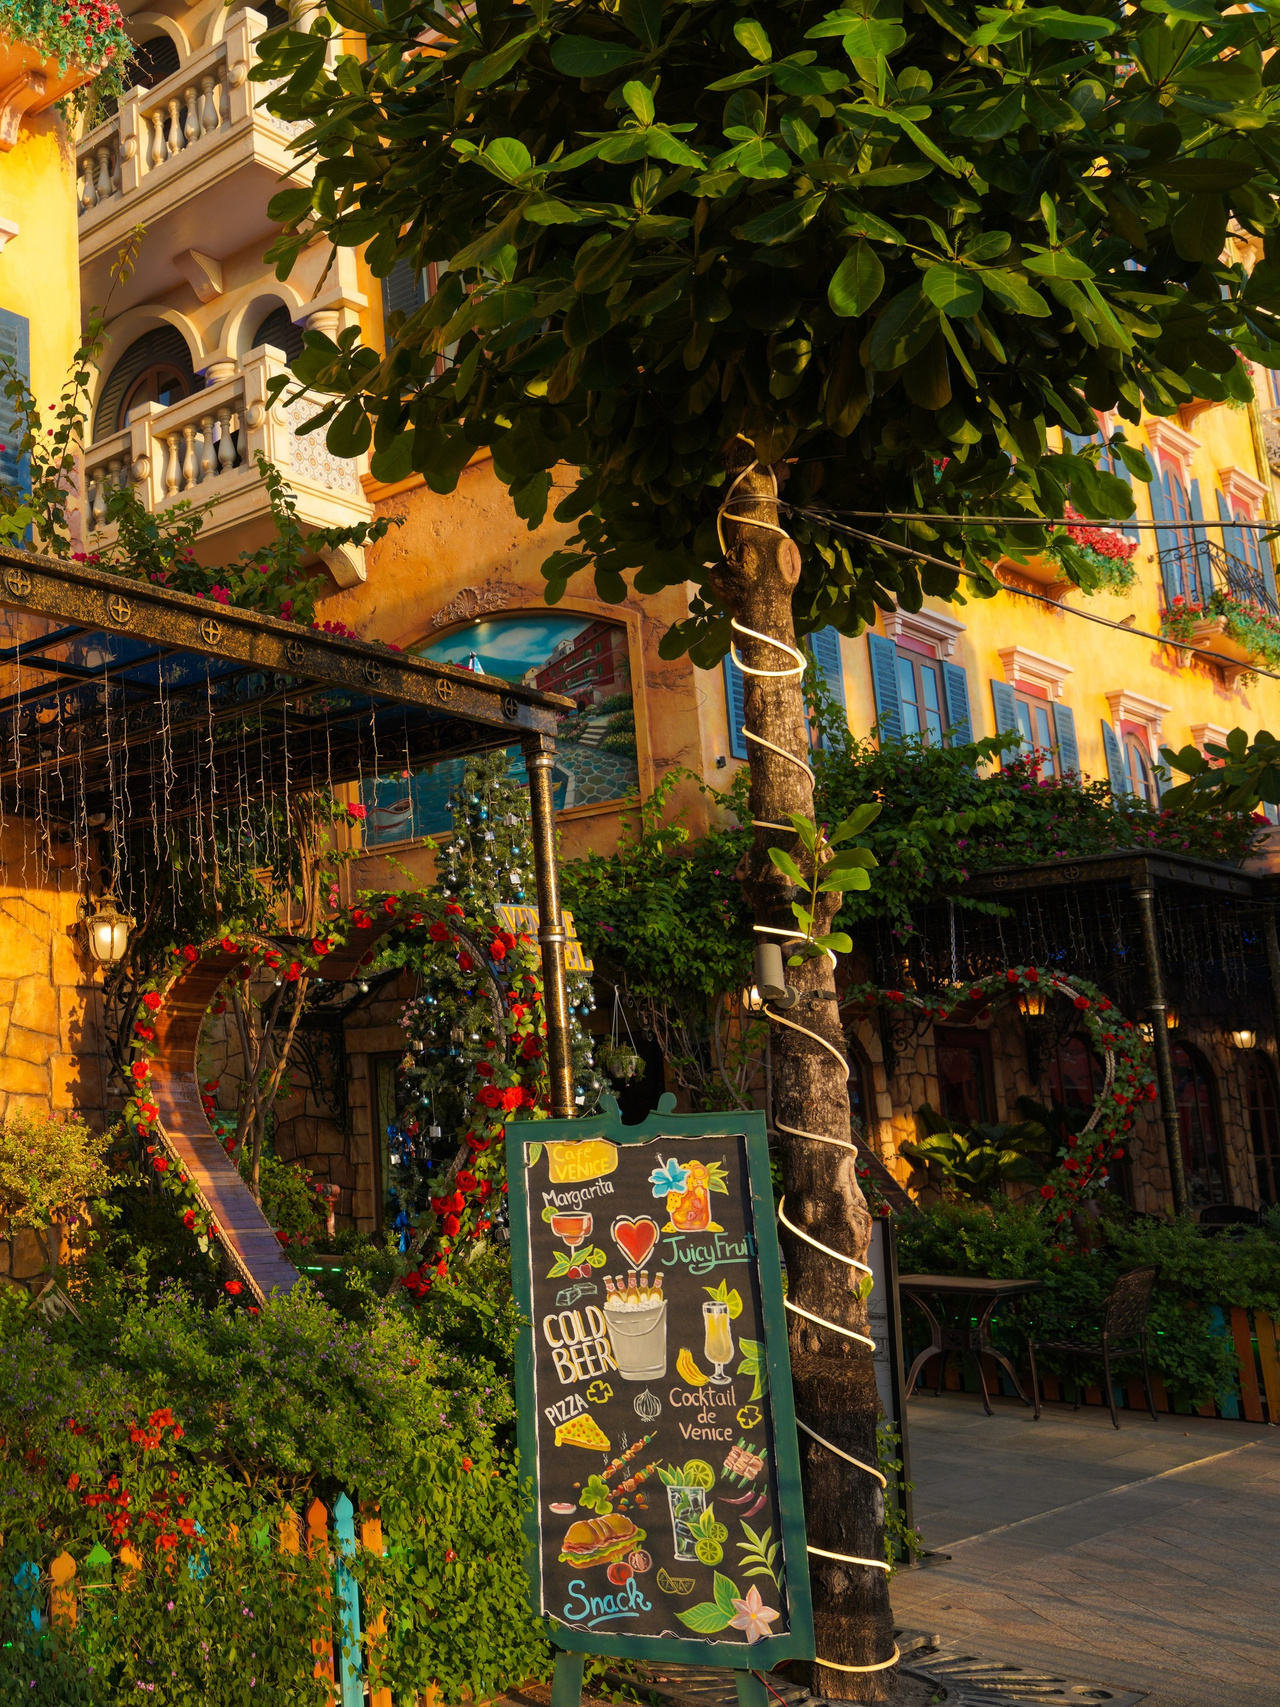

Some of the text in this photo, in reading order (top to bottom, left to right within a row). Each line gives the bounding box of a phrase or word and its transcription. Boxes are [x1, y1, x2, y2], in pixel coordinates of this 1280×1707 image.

[555, 1157, 610, 1180] VENICE
[542, 1178, 615, 1211] Margarita
[543, 1305, 607, 1348] COLD
[552, 1337, 619, 1385] BEER
[544, 1393, 589, 1427] PIZZA
[669, 1385, 737, 1408] Cocktail
[697, 1405, 716, 1424] de
[678, 1422, 733, 1441] Venice
[563, 1577, 653, 1621] Snack
